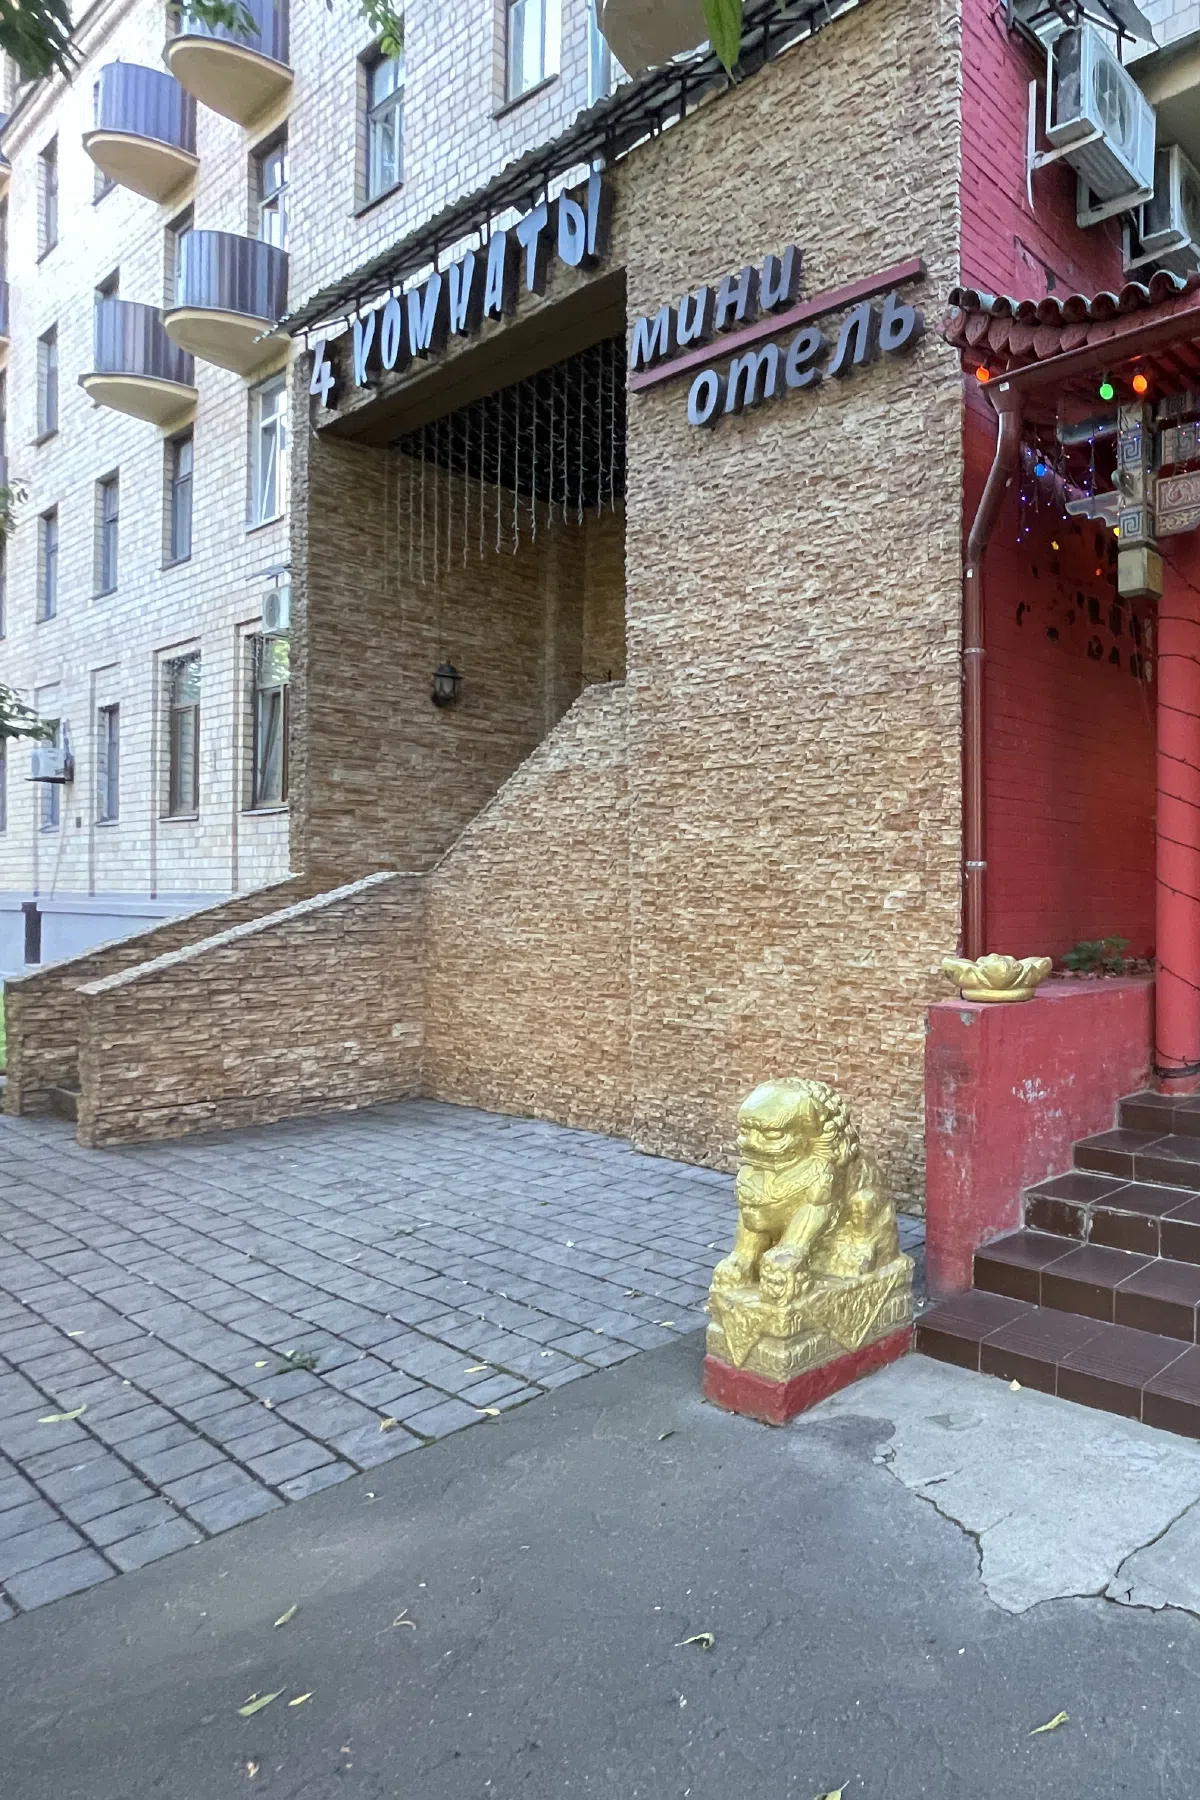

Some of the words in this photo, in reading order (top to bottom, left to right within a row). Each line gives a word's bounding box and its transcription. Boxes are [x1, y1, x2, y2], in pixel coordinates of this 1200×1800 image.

[310, 340, 335, 407] 4
[353, 170, 603, 387] КОМНАТЫ
[687, 292, 920, 428] отель
